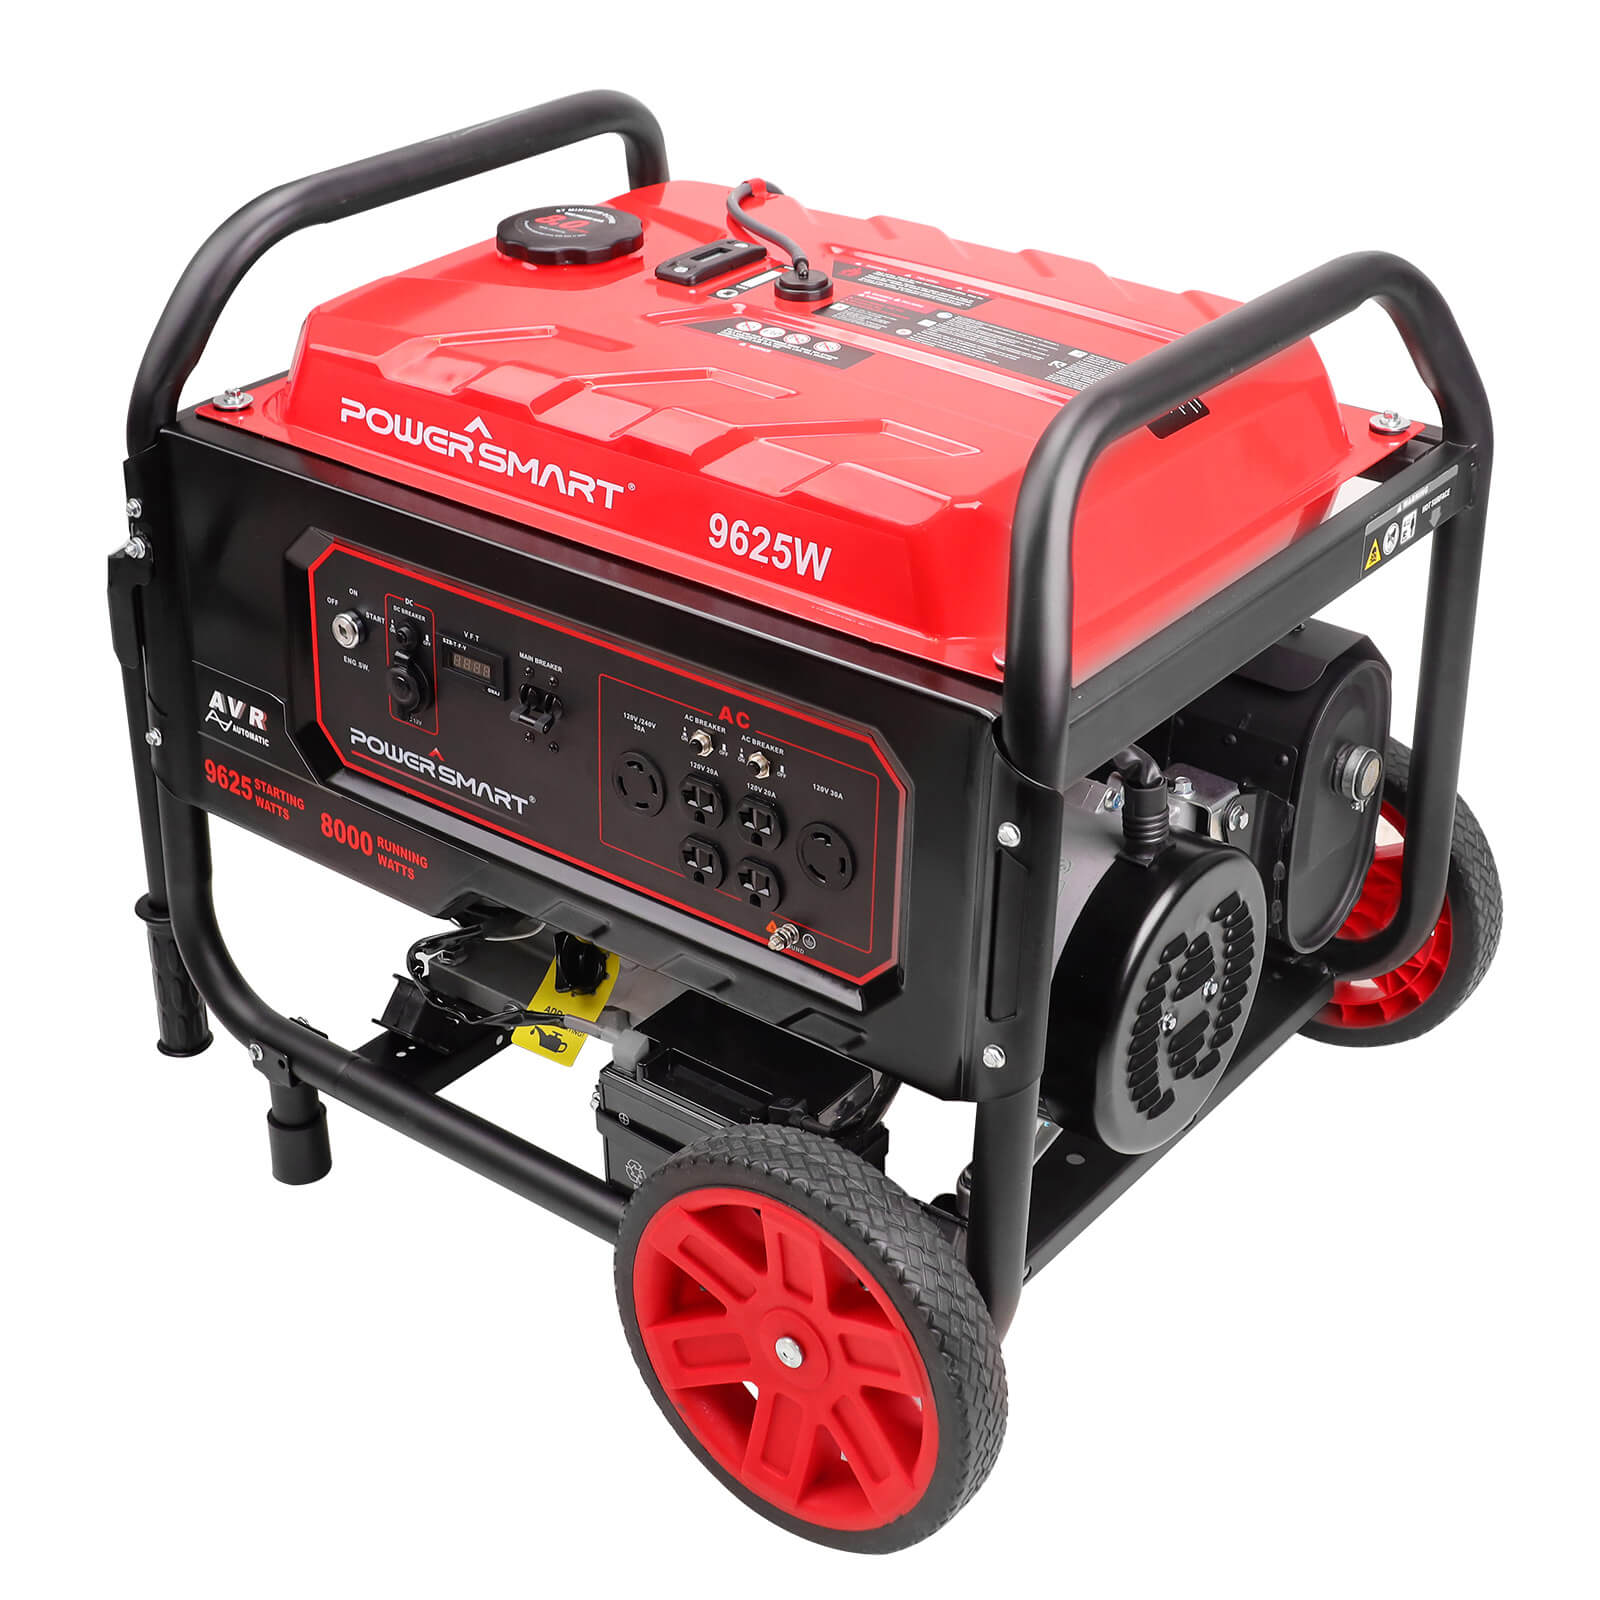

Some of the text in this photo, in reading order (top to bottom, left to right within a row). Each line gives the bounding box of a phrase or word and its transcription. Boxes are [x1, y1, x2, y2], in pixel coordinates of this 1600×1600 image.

[341, 397, 624, 509] POWERSMART
[708, 512, 832, 581] 9625W
[326, 596, 338, 606] OFF
[348, 588, 358, 597] ON
[404, 597, 414, 607] DC
[365, 611, 385, 624] START
[401, 608, 426, 622] BREAKER
[519, 651, 563, 673] MAIN BREAKER
[208, 690, 268, 731] AVR
[623, 712, 639, 722] 120V
[718, 705, 751, 729] AC
[633, 723, 646, 734] 30A
[684, 713, 726, 734] AC BREAKER
[232, 724, 270, 747] AUTOMATIC
[741, 734, 785, 756] AC BREAKER
[718, 749, 729, 758] OFF
[204, 758, 253, 801] 9625
[350, 727, 529, 815] POWERSMART
[689, 761, 719, 777] 120V 20A
[776, 771, 787, 779] OFF
[254, 778, 305, 811] STARTING
[746, 782, 777, 799] 120V 20A
[812, 783, 844, 800] 120V 30A
[254, 795, 291, 821] WATTS
[320, 812, 374, 857] 8000
[376, 835, 429, 869] RUNNING
[376, 853, 416, 881] WATTS
